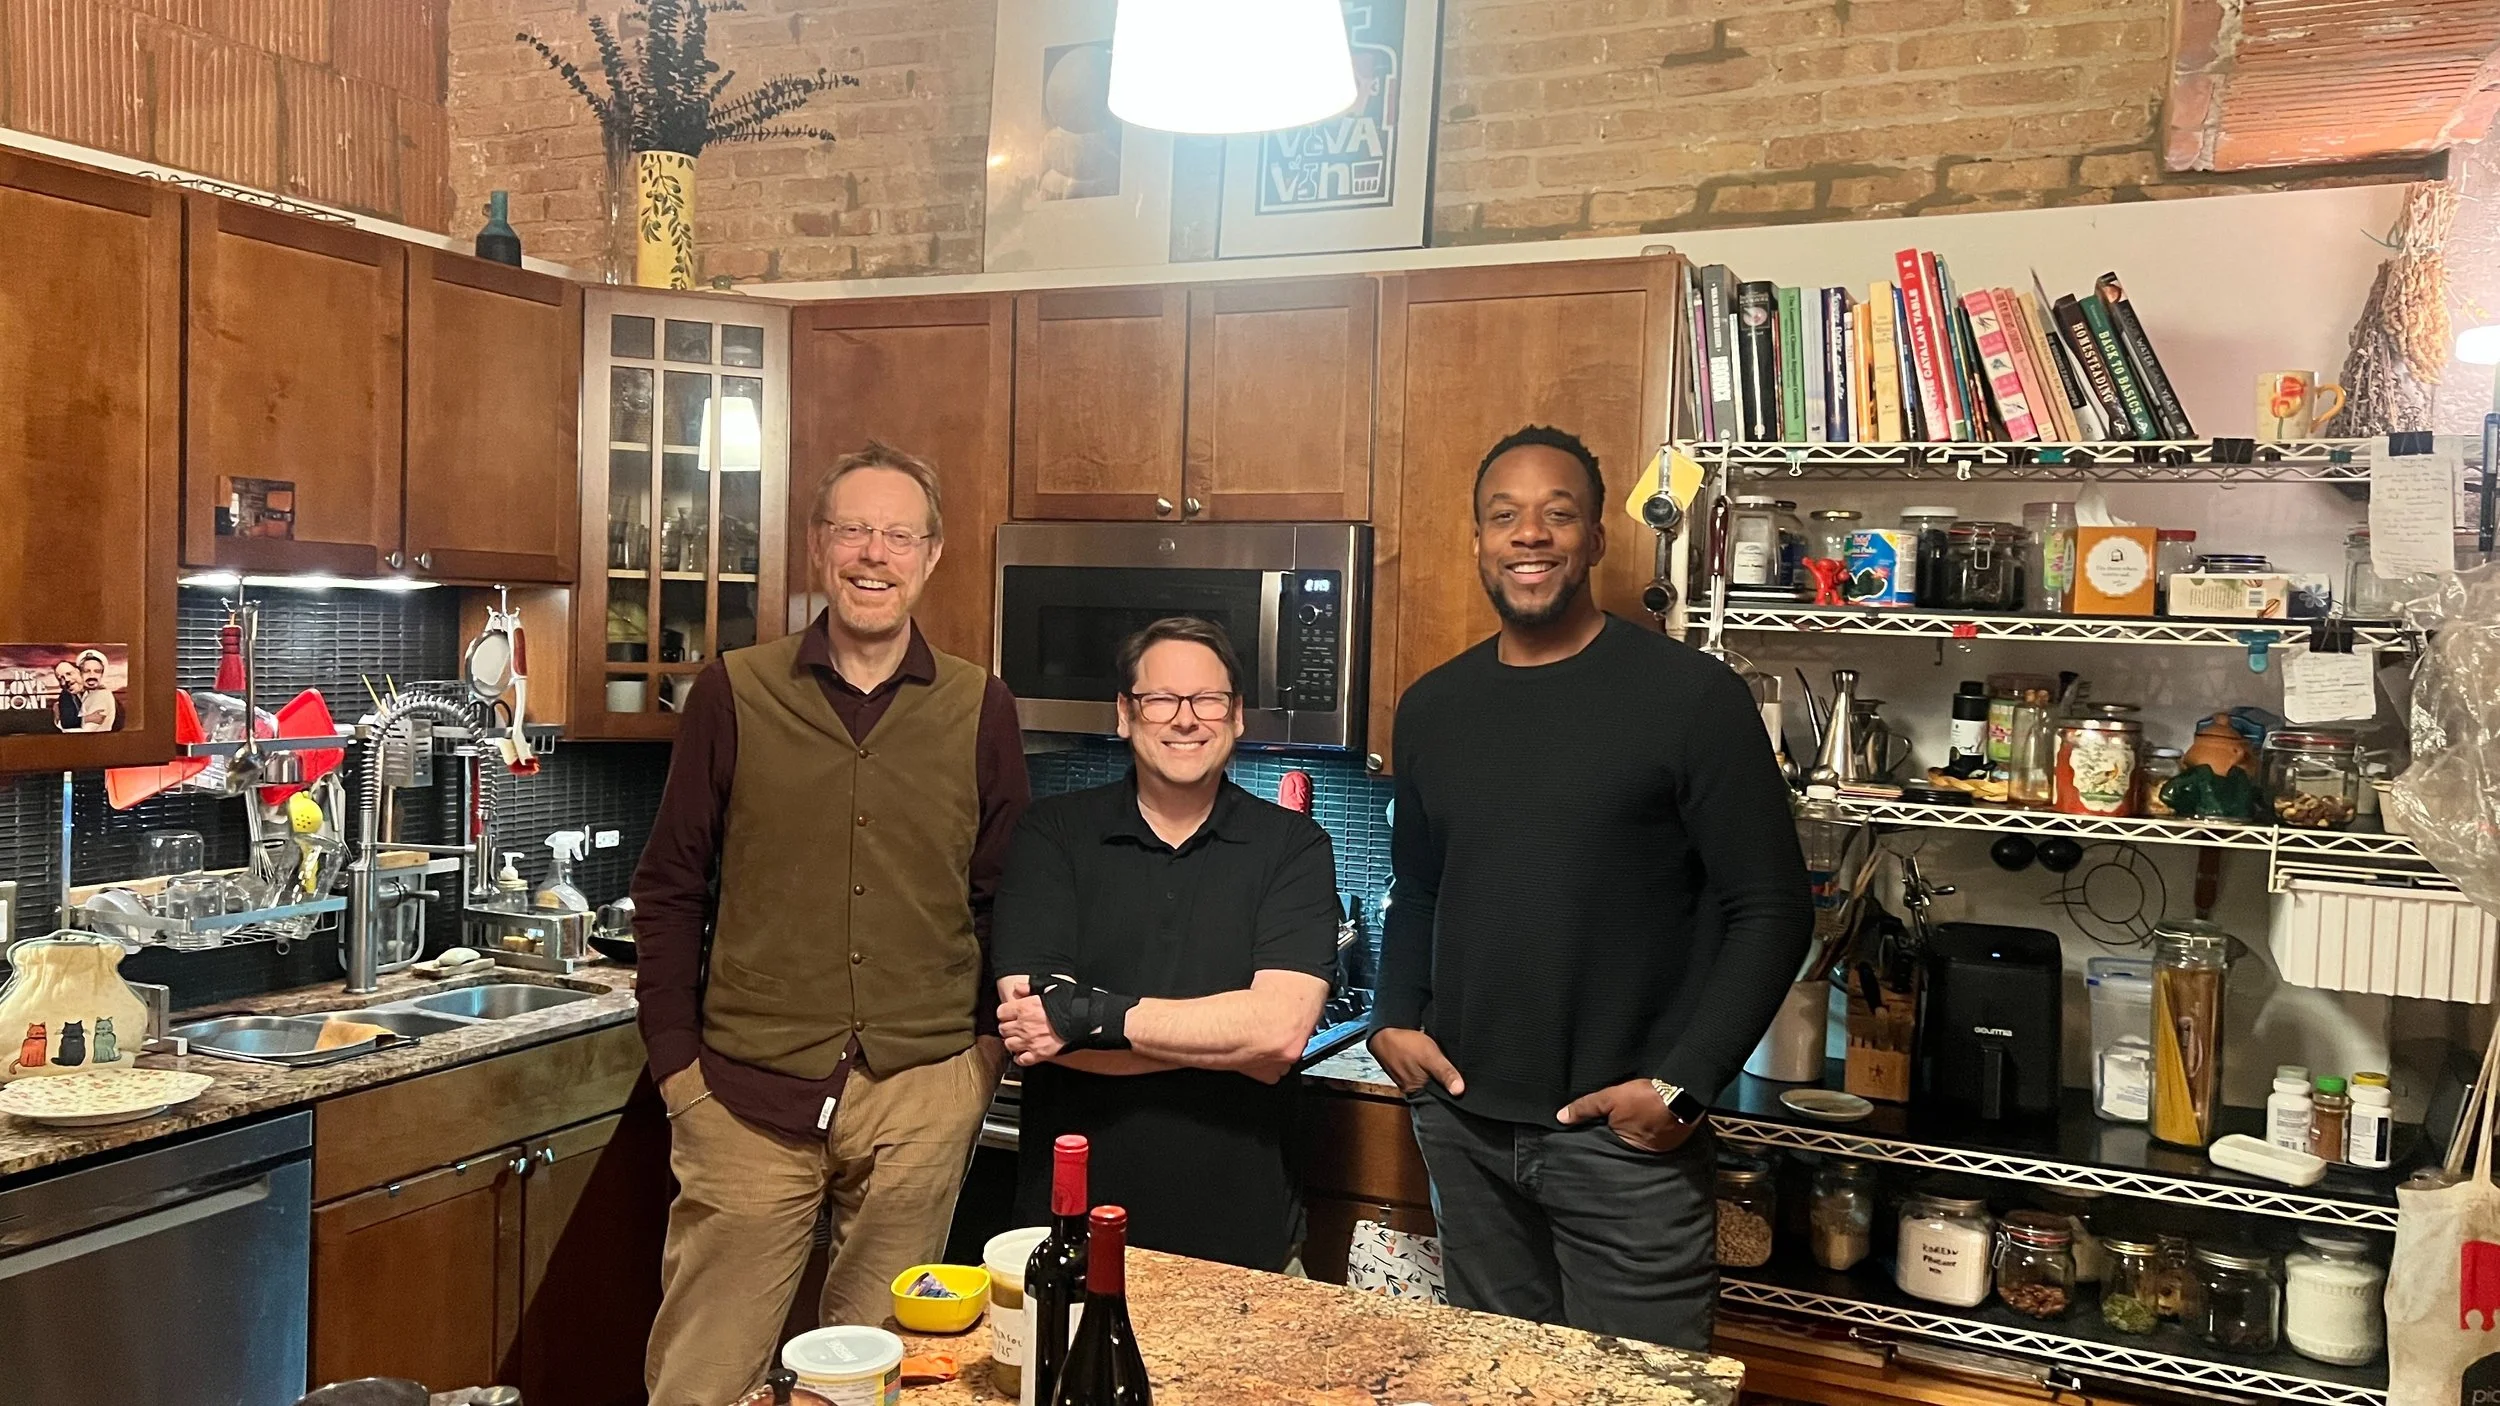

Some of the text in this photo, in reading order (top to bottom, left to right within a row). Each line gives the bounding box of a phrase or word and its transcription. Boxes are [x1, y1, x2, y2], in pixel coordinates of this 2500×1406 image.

[1909, 288, 1921, 325] TABLE
[1915, 326, 1933, 379] CATALAN
[2072, 321, 2114, 404] HOMESTEADING
[2098, 330, 2144, 416] BACK TO BASICS
[2137, 337, 2155, 367] WATER
[2160, 388, 2180, 416] YEAST
[0, 680, 46, 694] LOVE
[0, 695, 47, 710] BOAT
